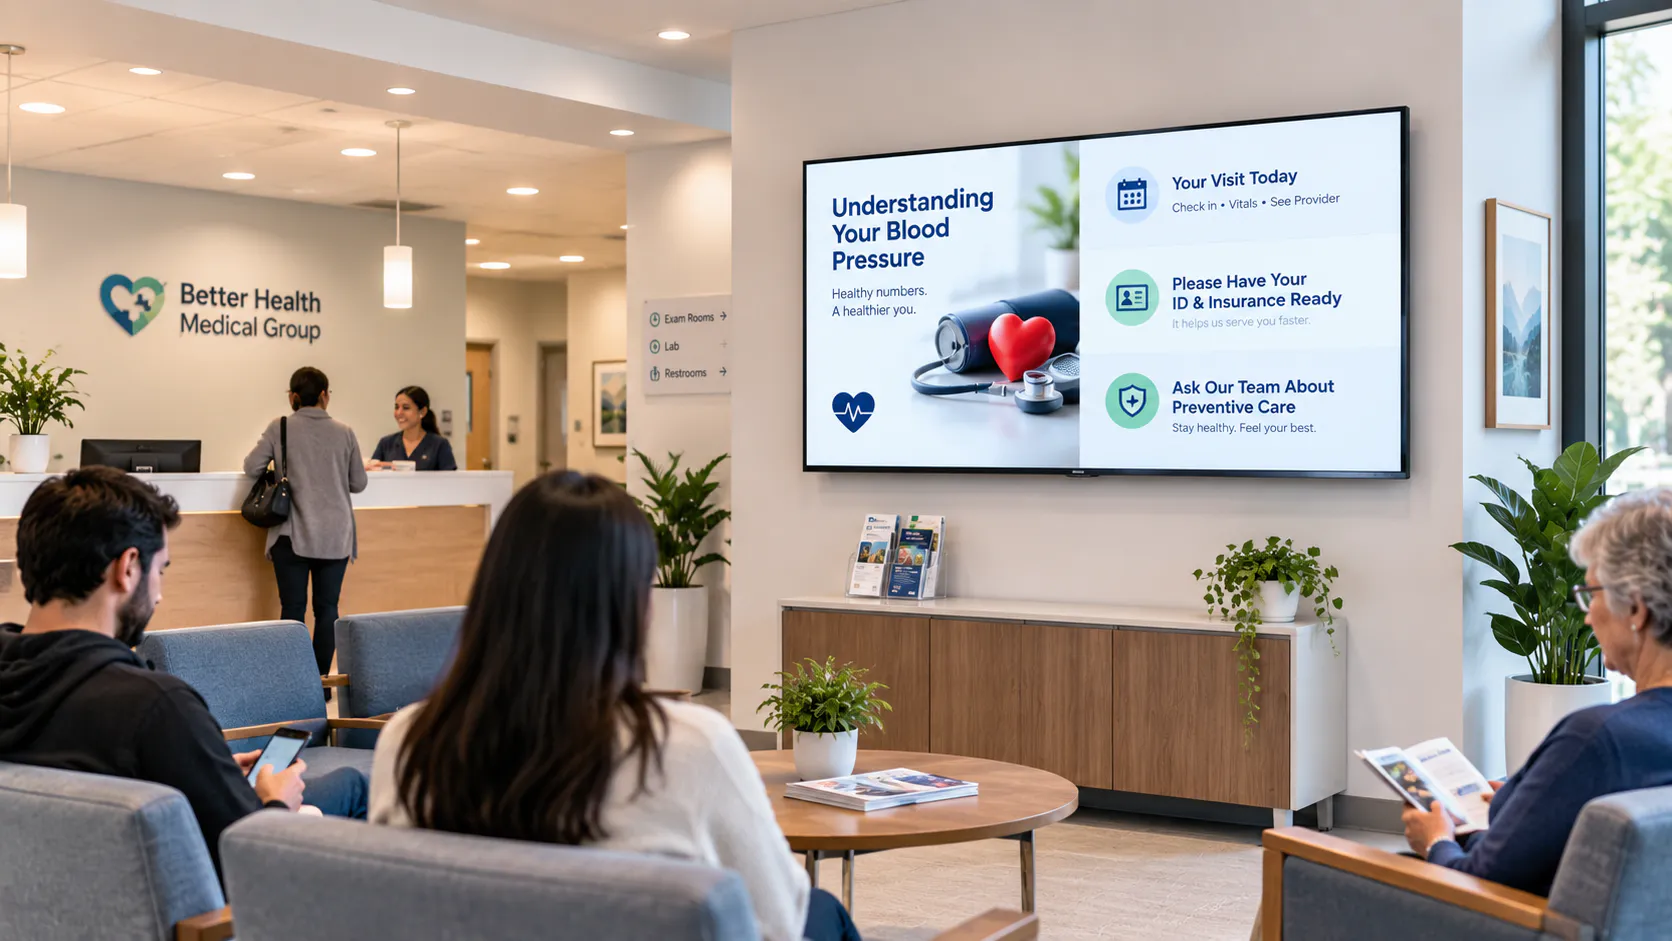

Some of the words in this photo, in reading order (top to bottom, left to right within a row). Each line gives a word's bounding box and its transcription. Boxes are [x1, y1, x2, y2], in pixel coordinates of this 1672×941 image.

[1171, 176, 1208, 191] Your
[1210, 171, 1246, 188] Visit
[1248, 168, 1298, 186] Today
[832, 187, 994, 213] Understanding
[1171, 201, 1206, 213] Check
[1207, 200, 1218, 211] in
[1228, 198, 1258, 210] Vitals
[1270, 196, 1292, 208] See
[1294, 193, 1341, 206] Provider
[831, 223, 881, 244] Your
[886, 216, 950, 241] Blood
[832, 250, 925, 271] Pressure
[1172, 276, 1223, 291] Please
[1226, 274, 1267, 289] Have
[1270, 272, 1308, 287] Your
[180, 282, 249, 308] Better
[254, 288, 321, 314] Health
[832, 286, 874, 301] Healthy
[876, 285, 928, 298] numbers.
[1172, 296, 1189, 310] ID
[1192, 295, 1205, 310] &
[1208, 295, 1286, 309] Insurance
[1290, 290, 1343, 309] Ready
[664, 313, 686, 325] Exam
[687, 312, 715, 323] Rooms
[831, 305, 841, 317] A
[843, 303, 891, 317] healthier
[892, 305, 917, 318] you.
[180, 312, 258, 337] Medical
[263, 317, 322, 345] Group
[1172, 318, 1180, 329] It
[1181, 317, 1209, 331] helps
[1211, 319, 1224, 328] us
[1225, 318, 1255, 328] serve
[1256, 318, 1276, 329] you
[1278, 314, 1311, 326] faster.
[664, 341, 680, 352] Lab
[664, 367, 707, 379] Restrooms
[1172, 380, 1201, 395] Ask
[1204, 380, 1235, 395] Our
[1237, 379, 1281, 394] Team
[1284, 379, 1335, 394] About
[1172, 399, 1254, 414] Preventive
[1257, 399, 1296, 414] Care
[1172, 422, 1195, 435] Stay
[1196, 422, 1237, 435] healthy.
[1239, 422, 1262, 433] Feel
[1263, 424, 1288, 435] your
[1290, 422, 1317, 433] best.
